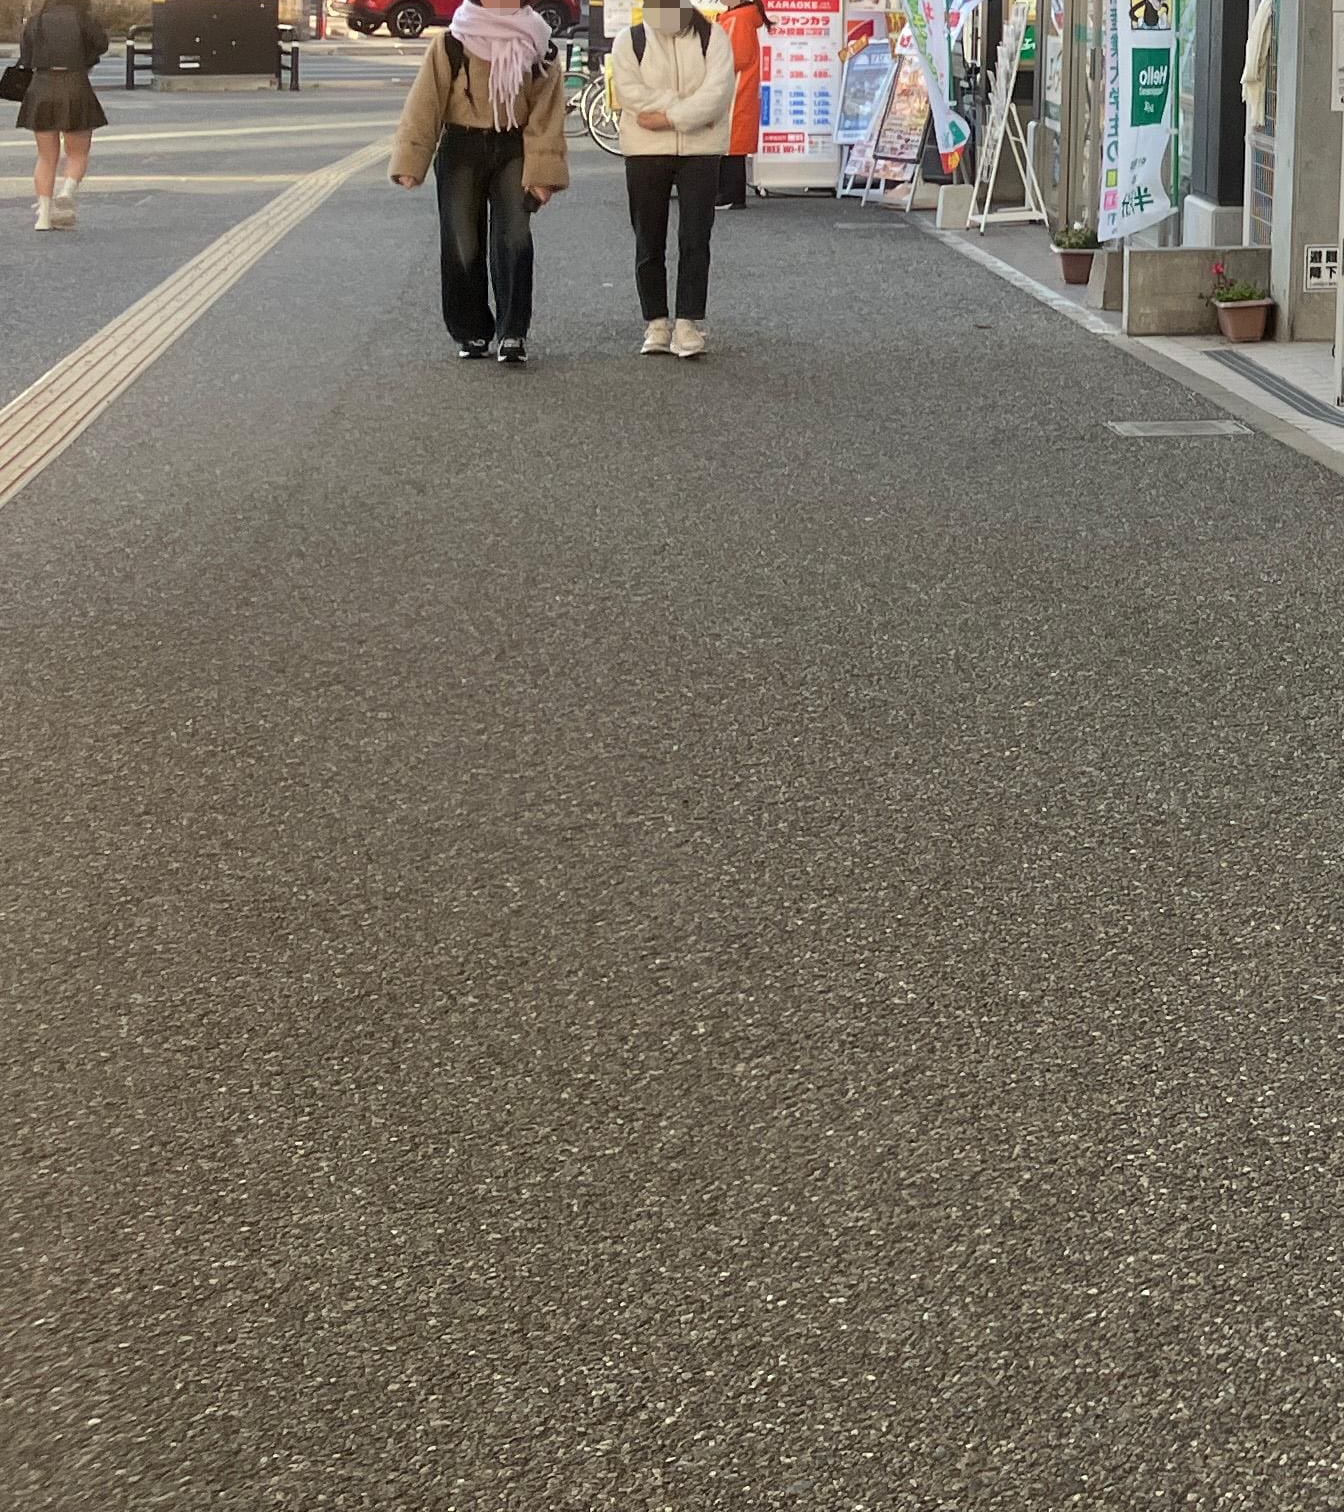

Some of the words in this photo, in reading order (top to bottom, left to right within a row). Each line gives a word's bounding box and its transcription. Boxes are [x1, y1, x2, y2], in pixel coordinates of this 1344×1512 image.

[780, 16, 830, 27] ジャンカラ
